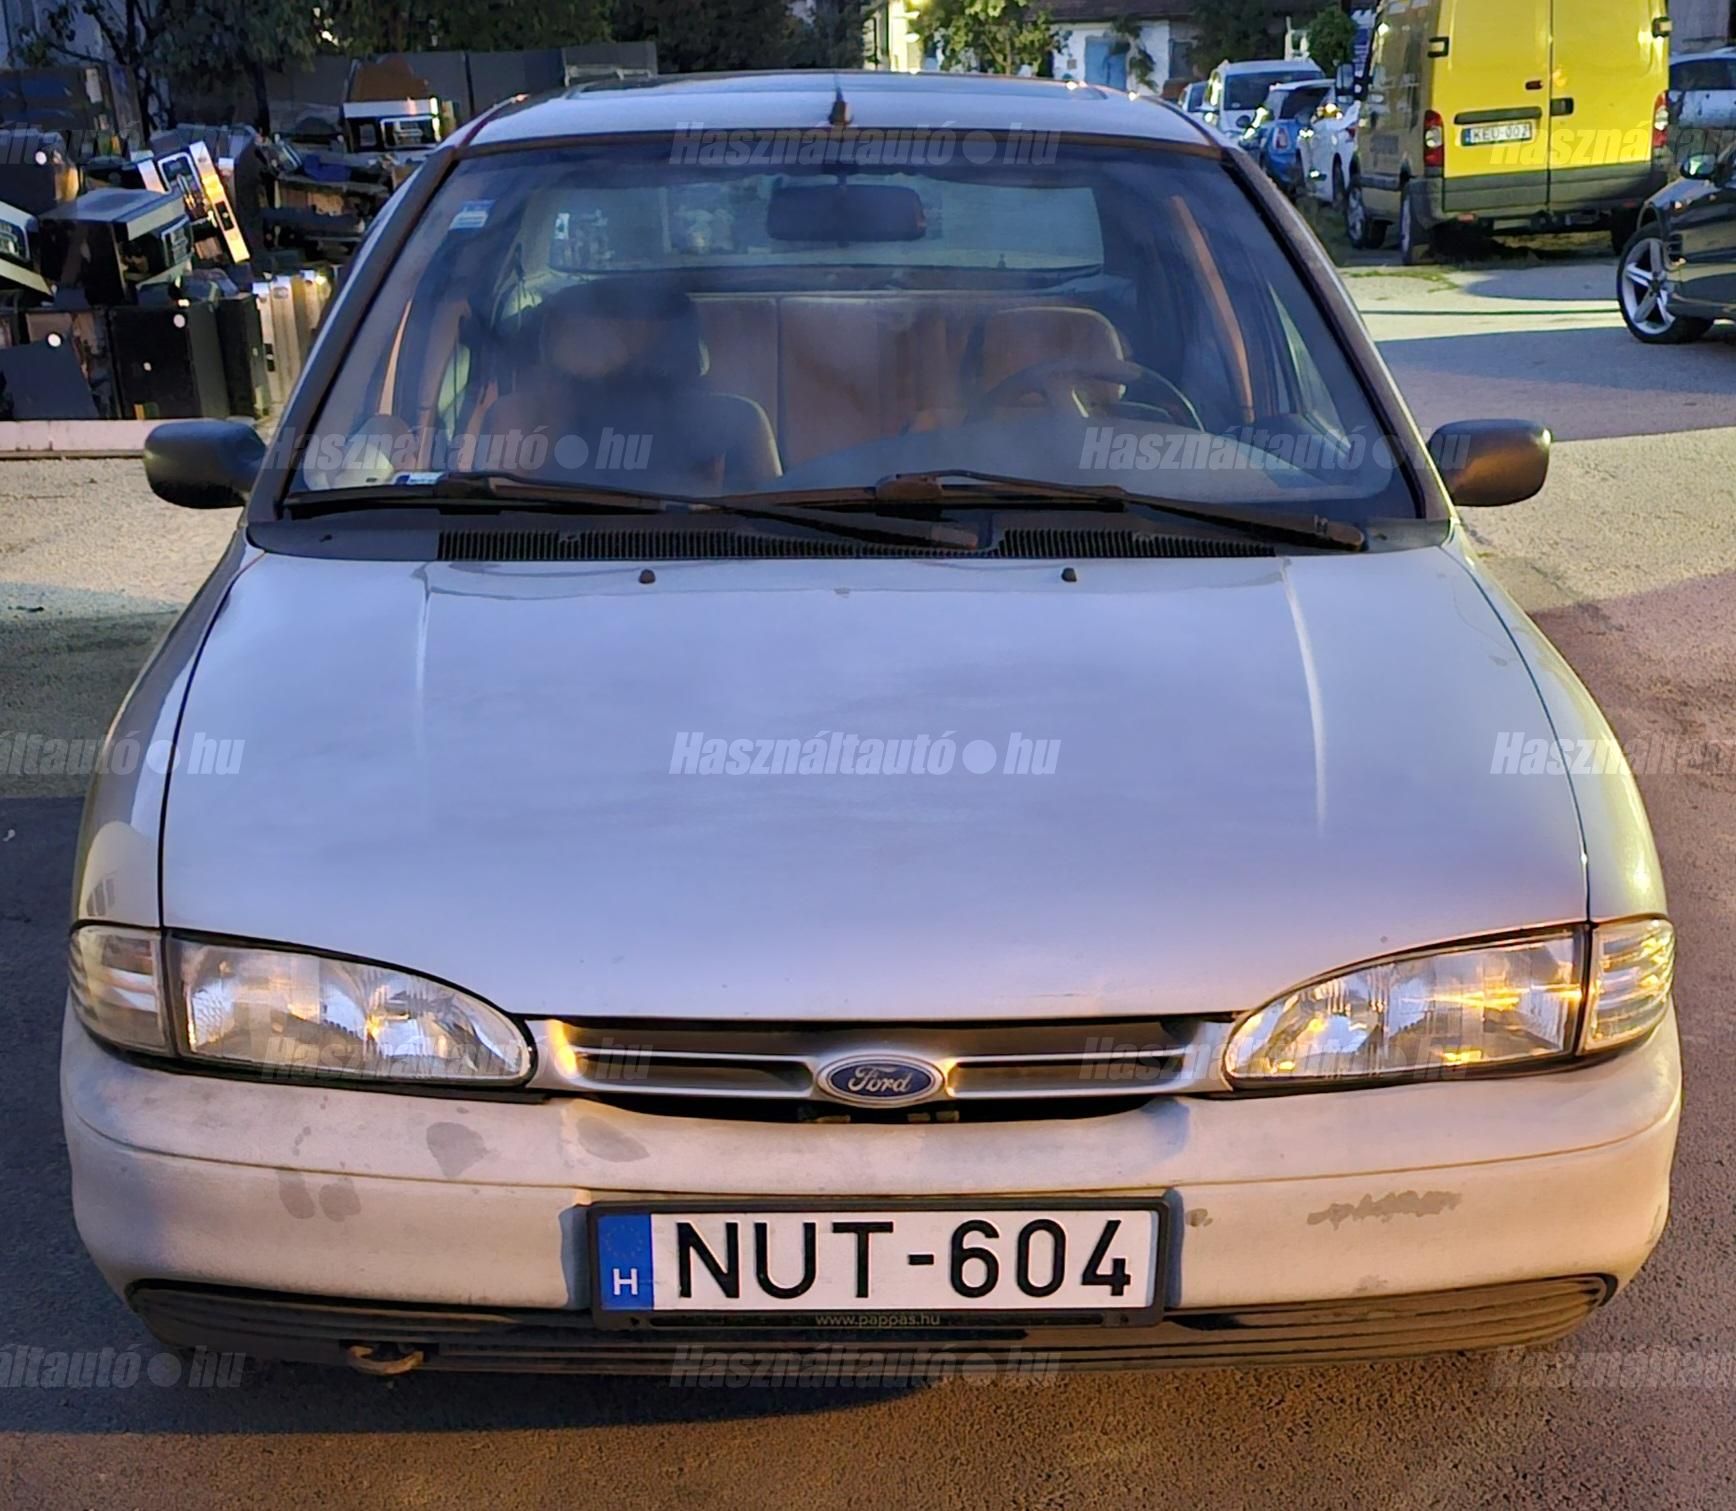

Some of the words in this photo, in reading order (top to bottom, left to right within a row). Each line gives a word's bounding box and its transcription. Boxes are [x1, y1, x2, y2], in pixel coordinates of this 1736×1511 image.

[848, 1065, 912, 1093] Ford
[676, 1219, 1131, 1299] NUT-604
[612, 1267, 639, 1296] H
[815, 1313, 941, 1328] www.pappas.hu
